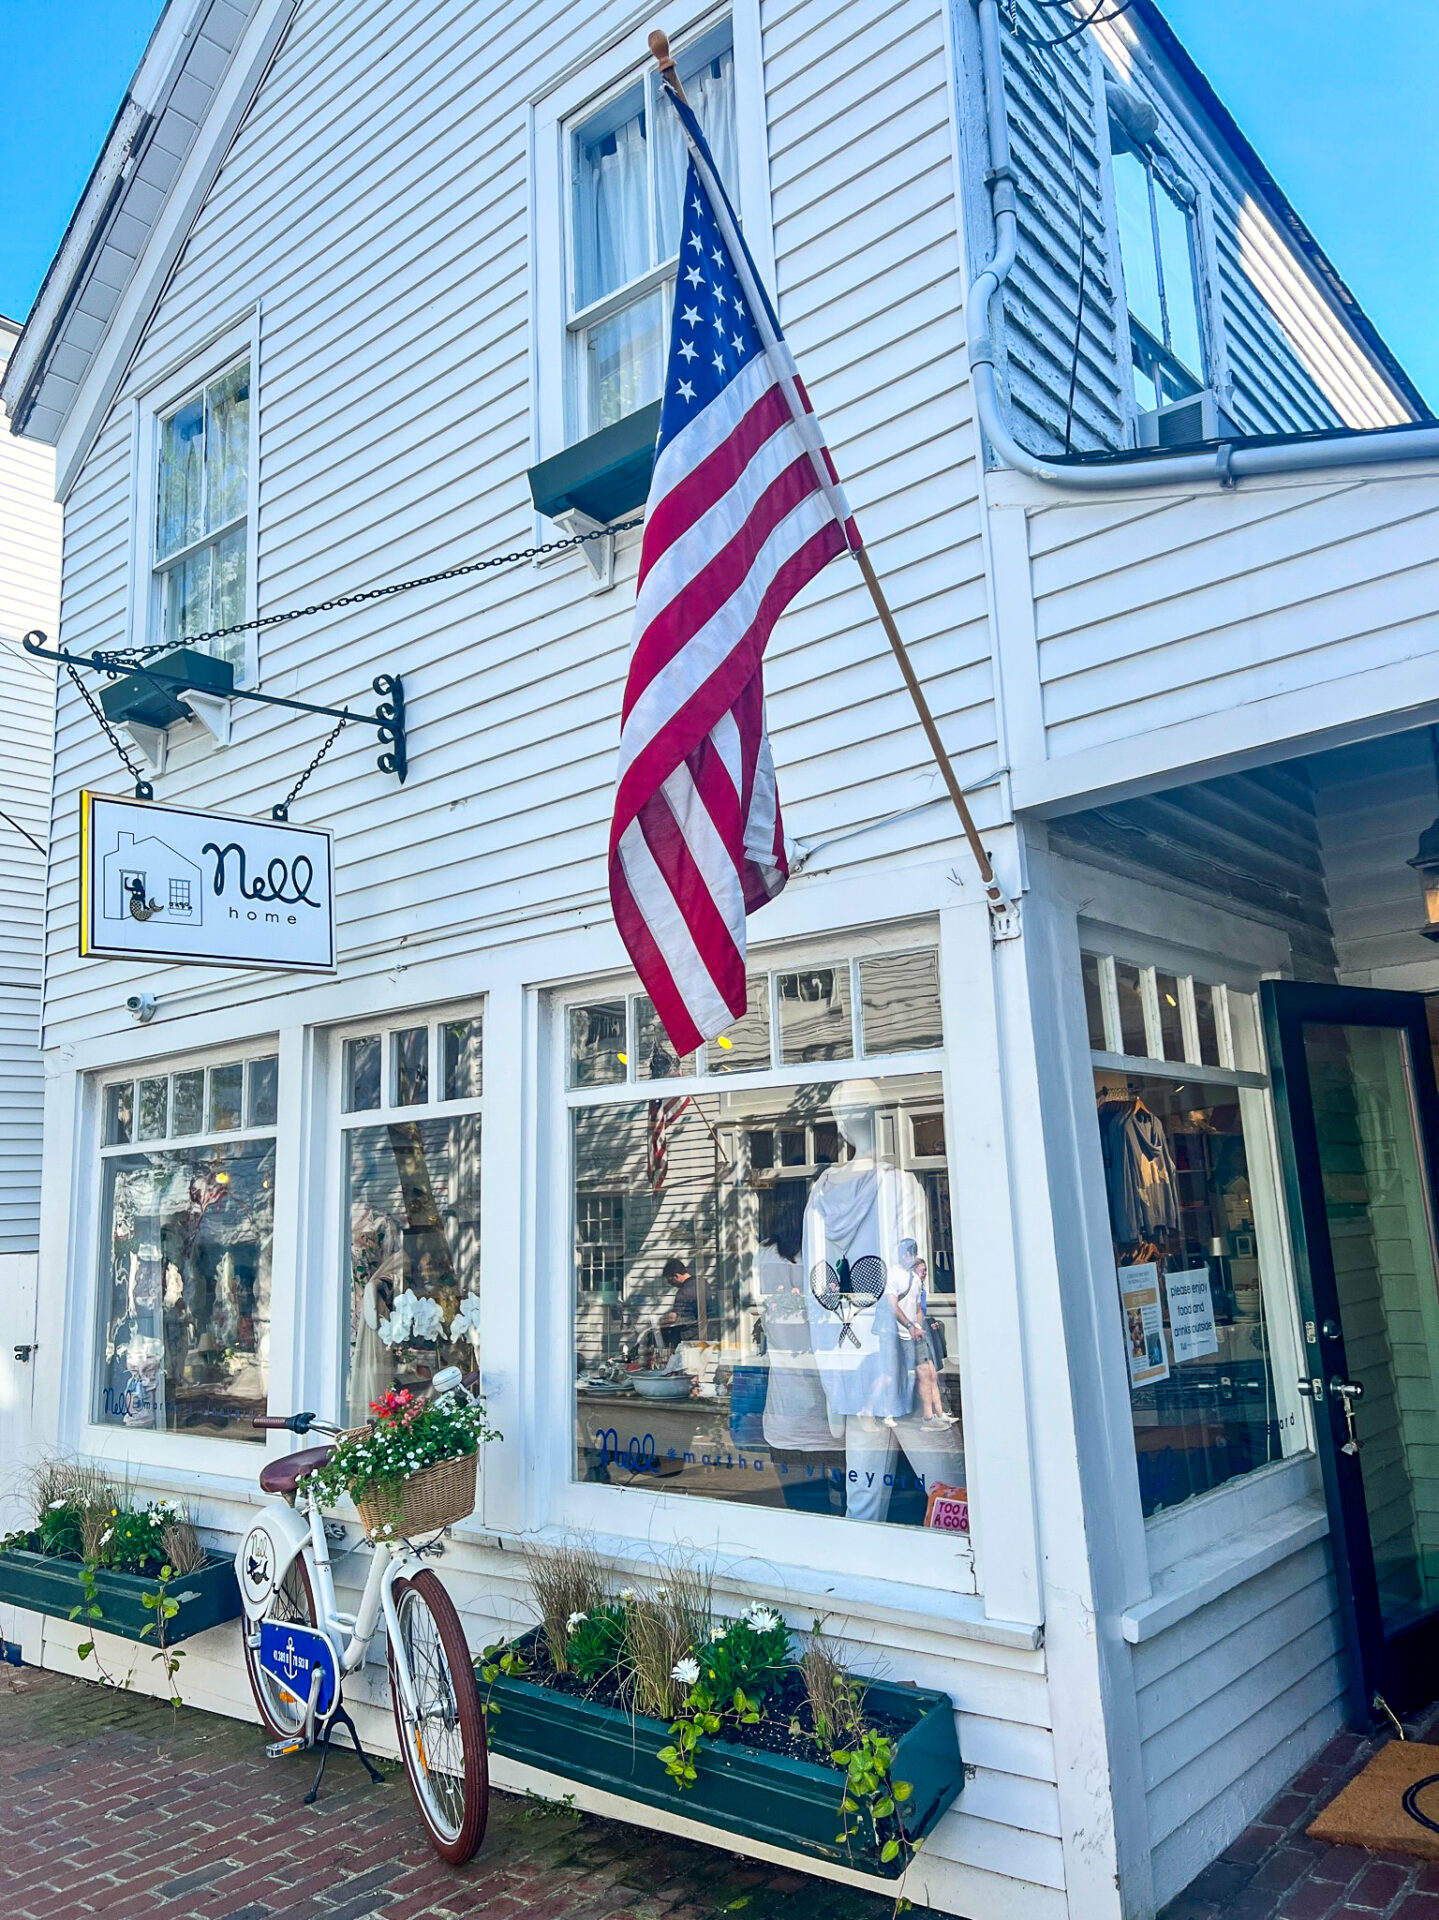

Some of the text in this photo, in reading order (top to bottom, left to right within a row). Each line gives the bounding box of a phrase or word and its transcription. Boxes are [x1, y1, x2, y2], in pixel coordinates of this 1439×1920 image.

[229, 907, 297, 925] home
[1171, 1285, 1191, 1299] please
[1192, 1281, 1208, 1295] enjoy
[1177, 1301, 1205, 1316] food and
[1174, 1320, 1212, 1337] drinks outside
[682, 1450, 789, 1475] marthas
[806, 1462, 926, 1491] vineyard
[940, 1501, 960, 1515] TOO
